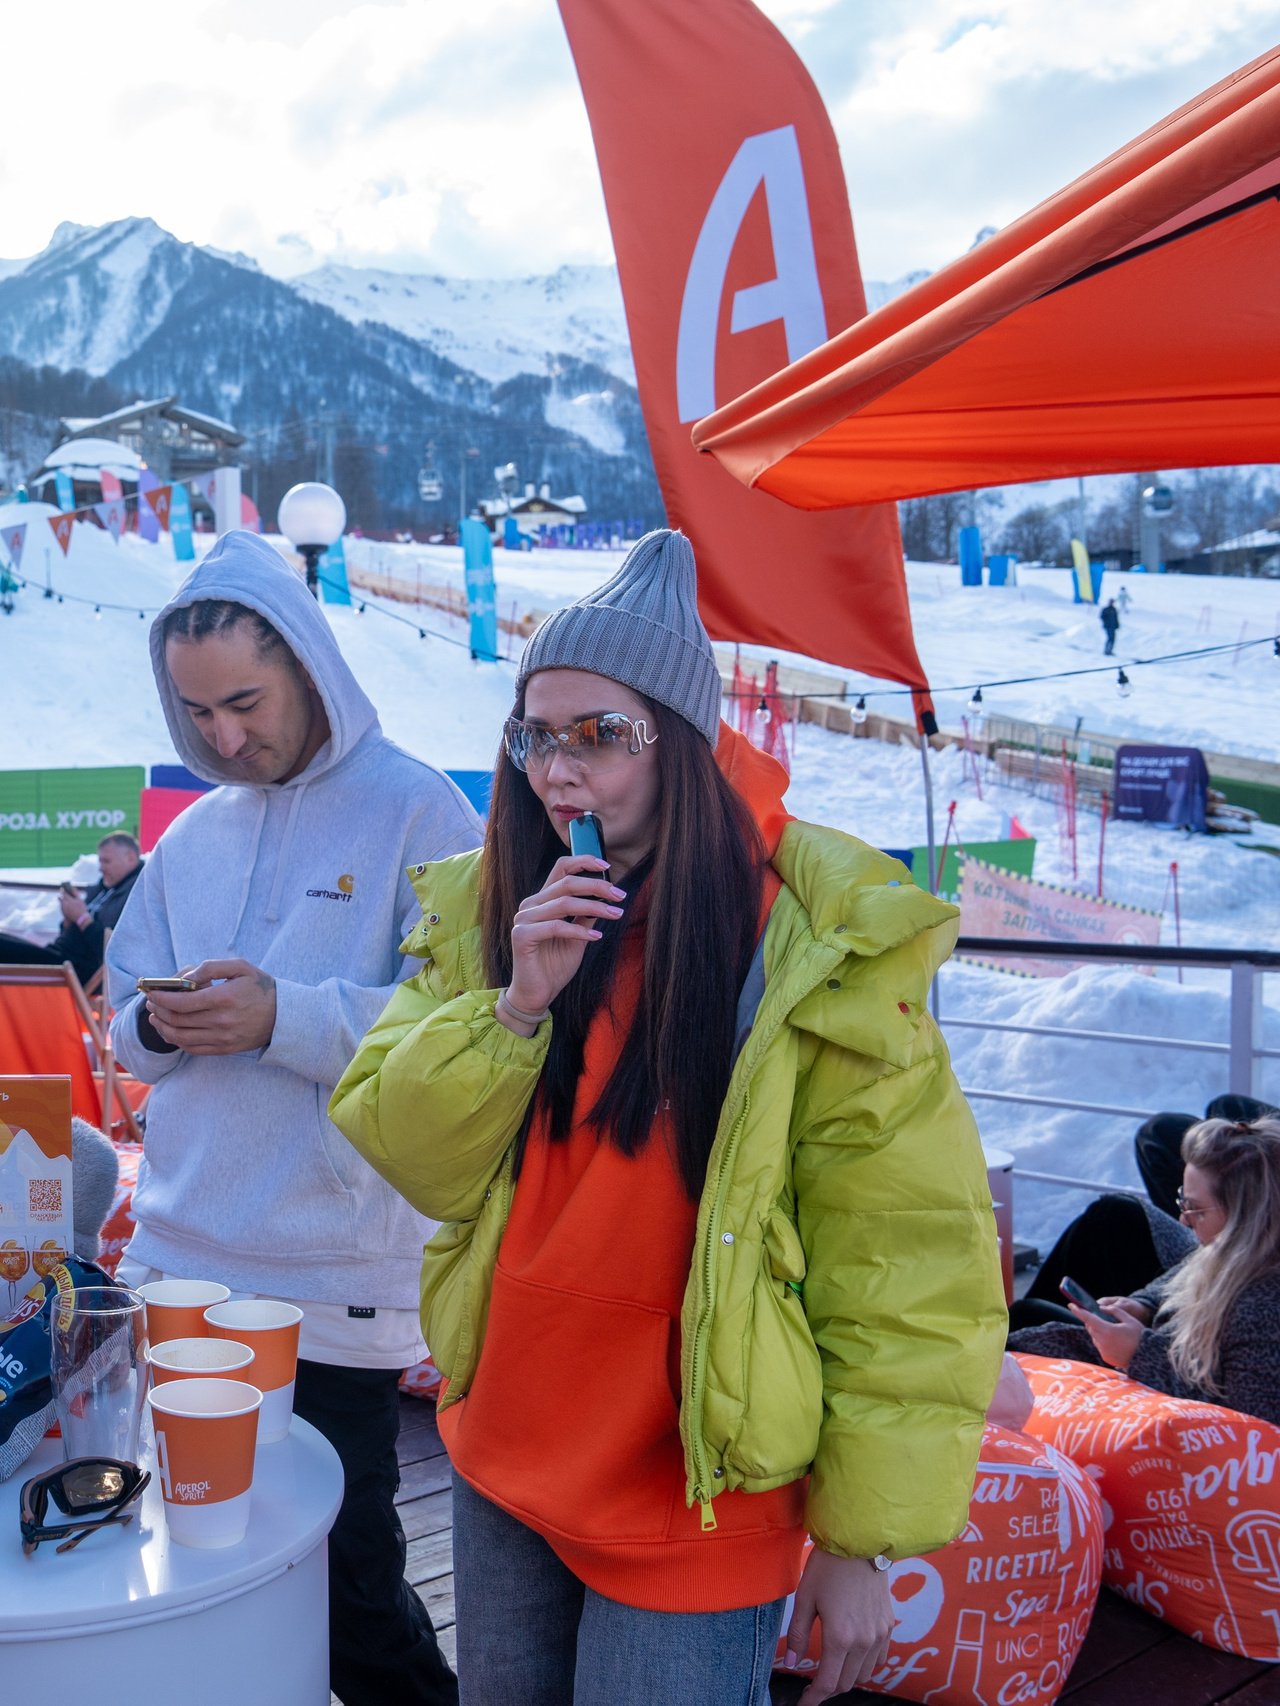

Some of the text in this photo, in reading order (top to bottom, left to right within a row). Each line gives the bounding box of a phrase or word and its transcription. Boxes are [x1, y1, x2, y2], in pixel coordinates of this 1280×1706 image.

[676, 124, 829, 425] A
[56, 809, 126, 829] ХУТОР
[306, 889, 353, 903] carhartt
[1177, 1425, 1224, 1454] BASE
[175, 1481, 211, 1495] APEROL
[180, 1490, 206, 1501] SPRITZ
